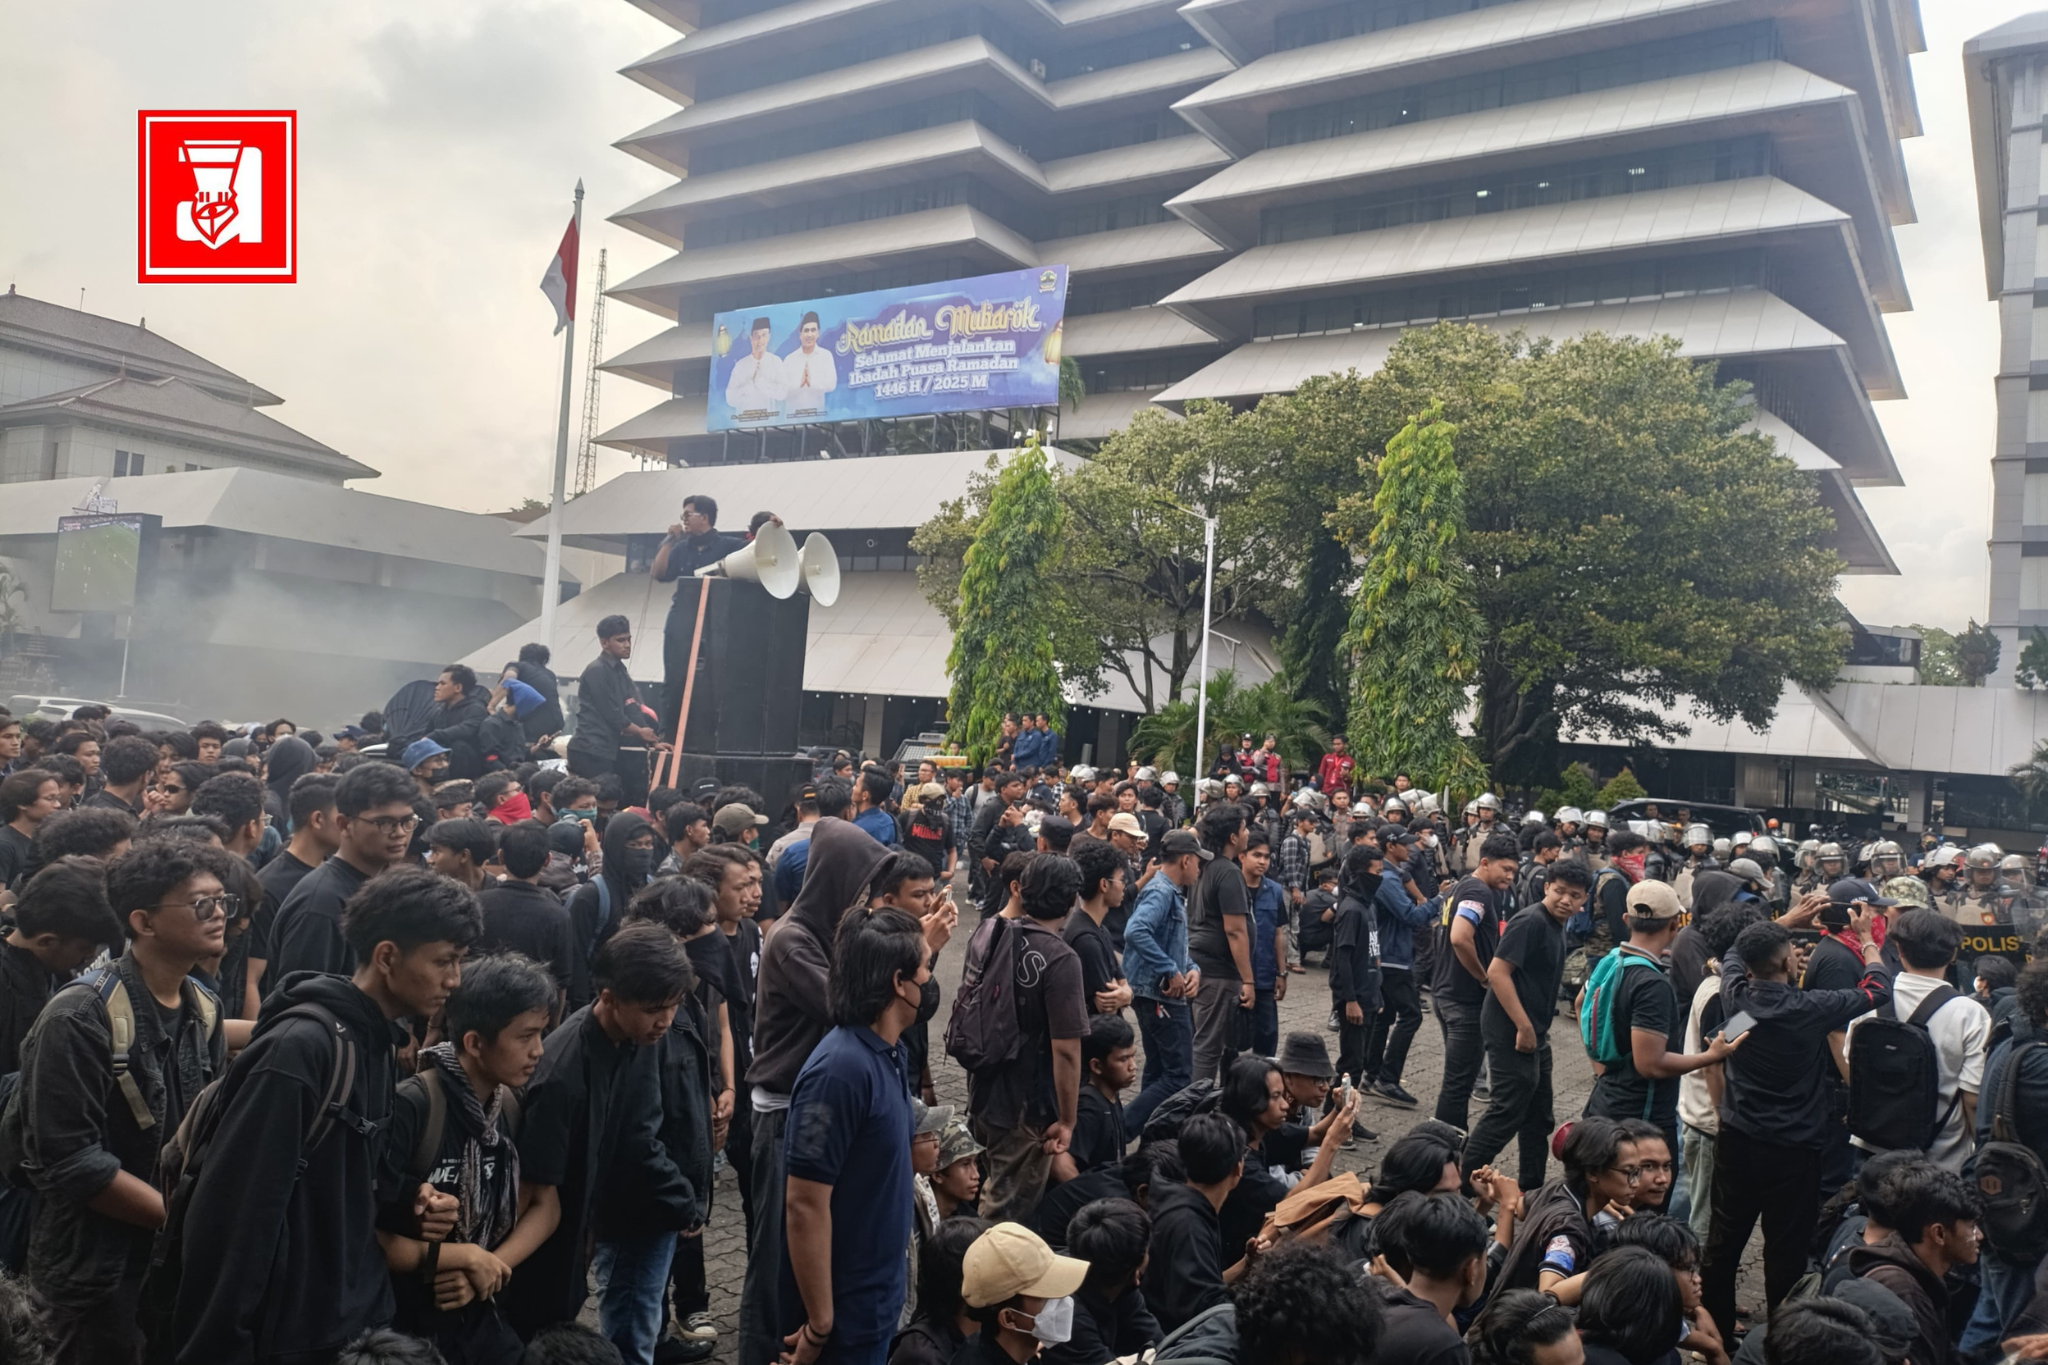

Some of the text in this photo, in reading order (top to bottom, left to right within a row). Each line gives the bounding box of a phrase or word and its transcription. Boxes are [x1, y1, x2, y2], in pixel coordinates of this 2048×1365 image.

[855, 337, 1015, 369] Selamat Menjalankan
[849, 354, 1018, 386] Ibadah Puasa Ramadan
[876, 381, 907, 398] 1446
[909, 379, 921, 393] H
[933, 376, 968, 391] 2025
[971, 374, 988, 389] M
[1961, 936, 2023, 952] POLIS
